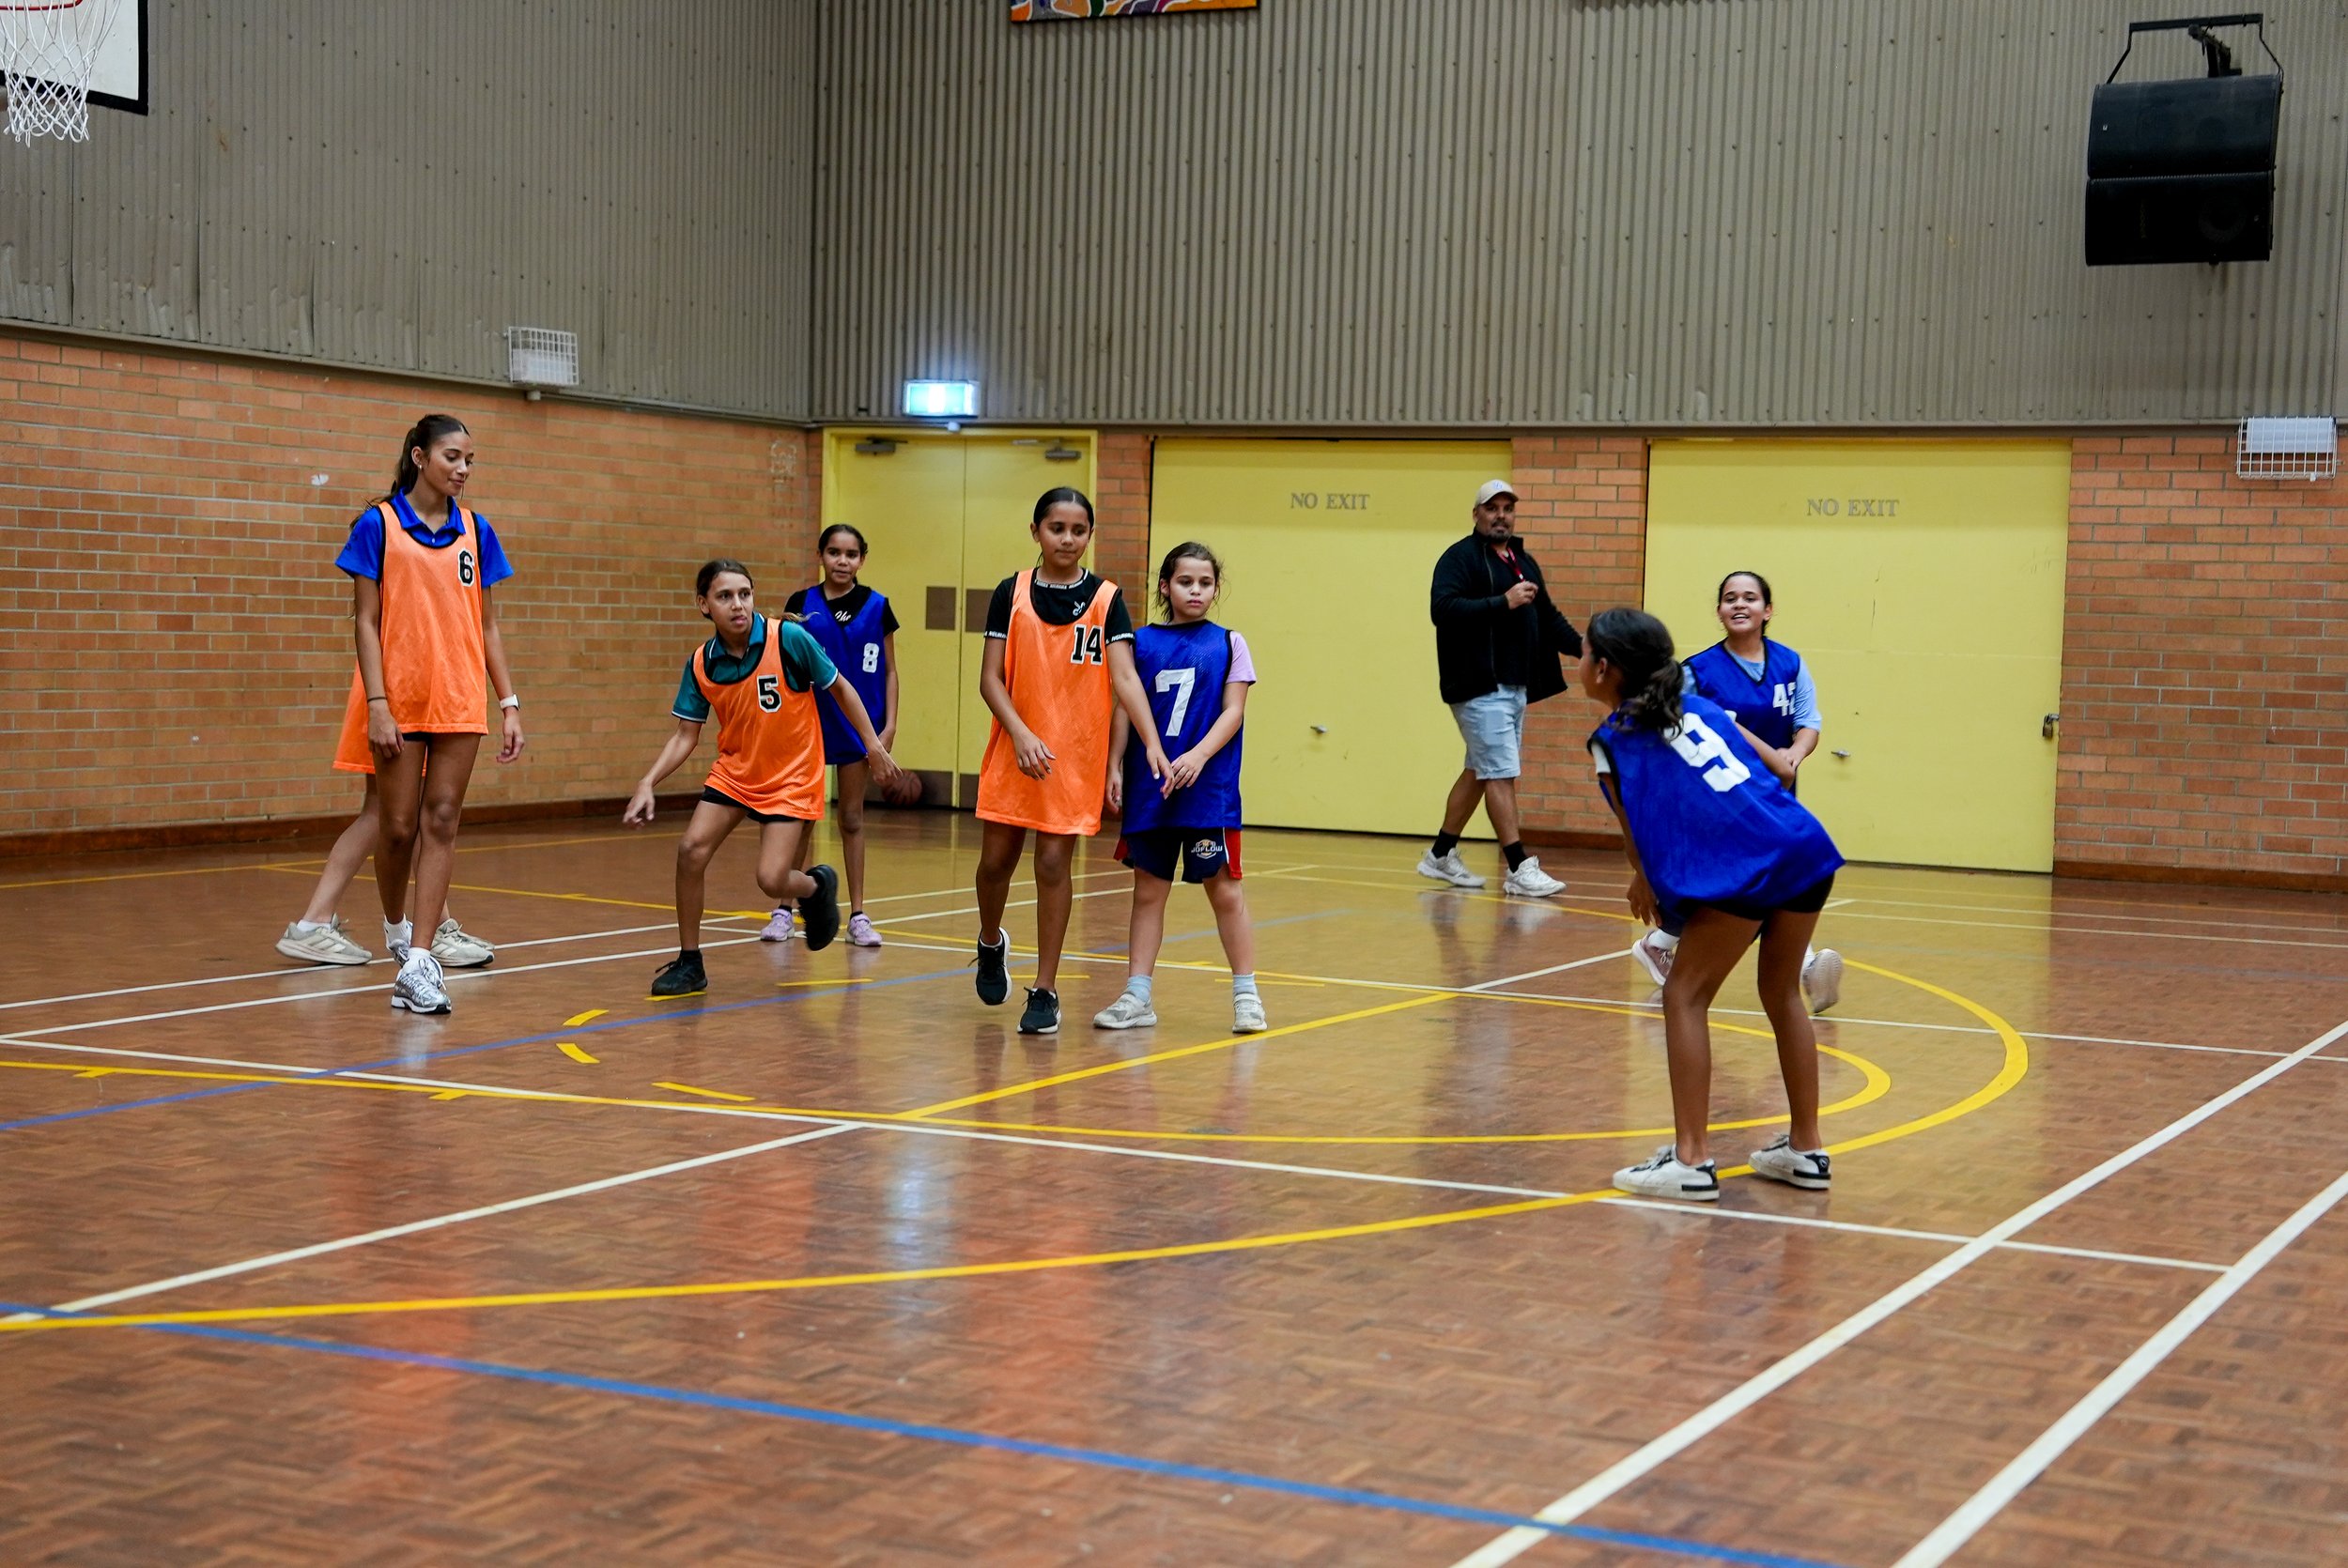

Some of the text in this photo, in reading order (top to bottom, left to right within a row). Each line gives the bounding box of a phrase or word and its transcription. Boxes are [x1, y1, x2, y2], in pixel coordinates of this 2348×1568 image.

[1290, 492, 1370, 510] NO EXIT
[1807, 499, 1900, 516] NO EXIT
[458, 548, 474, 587] 6
[862, 642, 880, 673] 8
[1071, 624, 1103, 665] 14
[757, 675, 781, 713] 5
[1155, 668, 1196, 736] 7
[1663, 713, 1752, 792] 9
